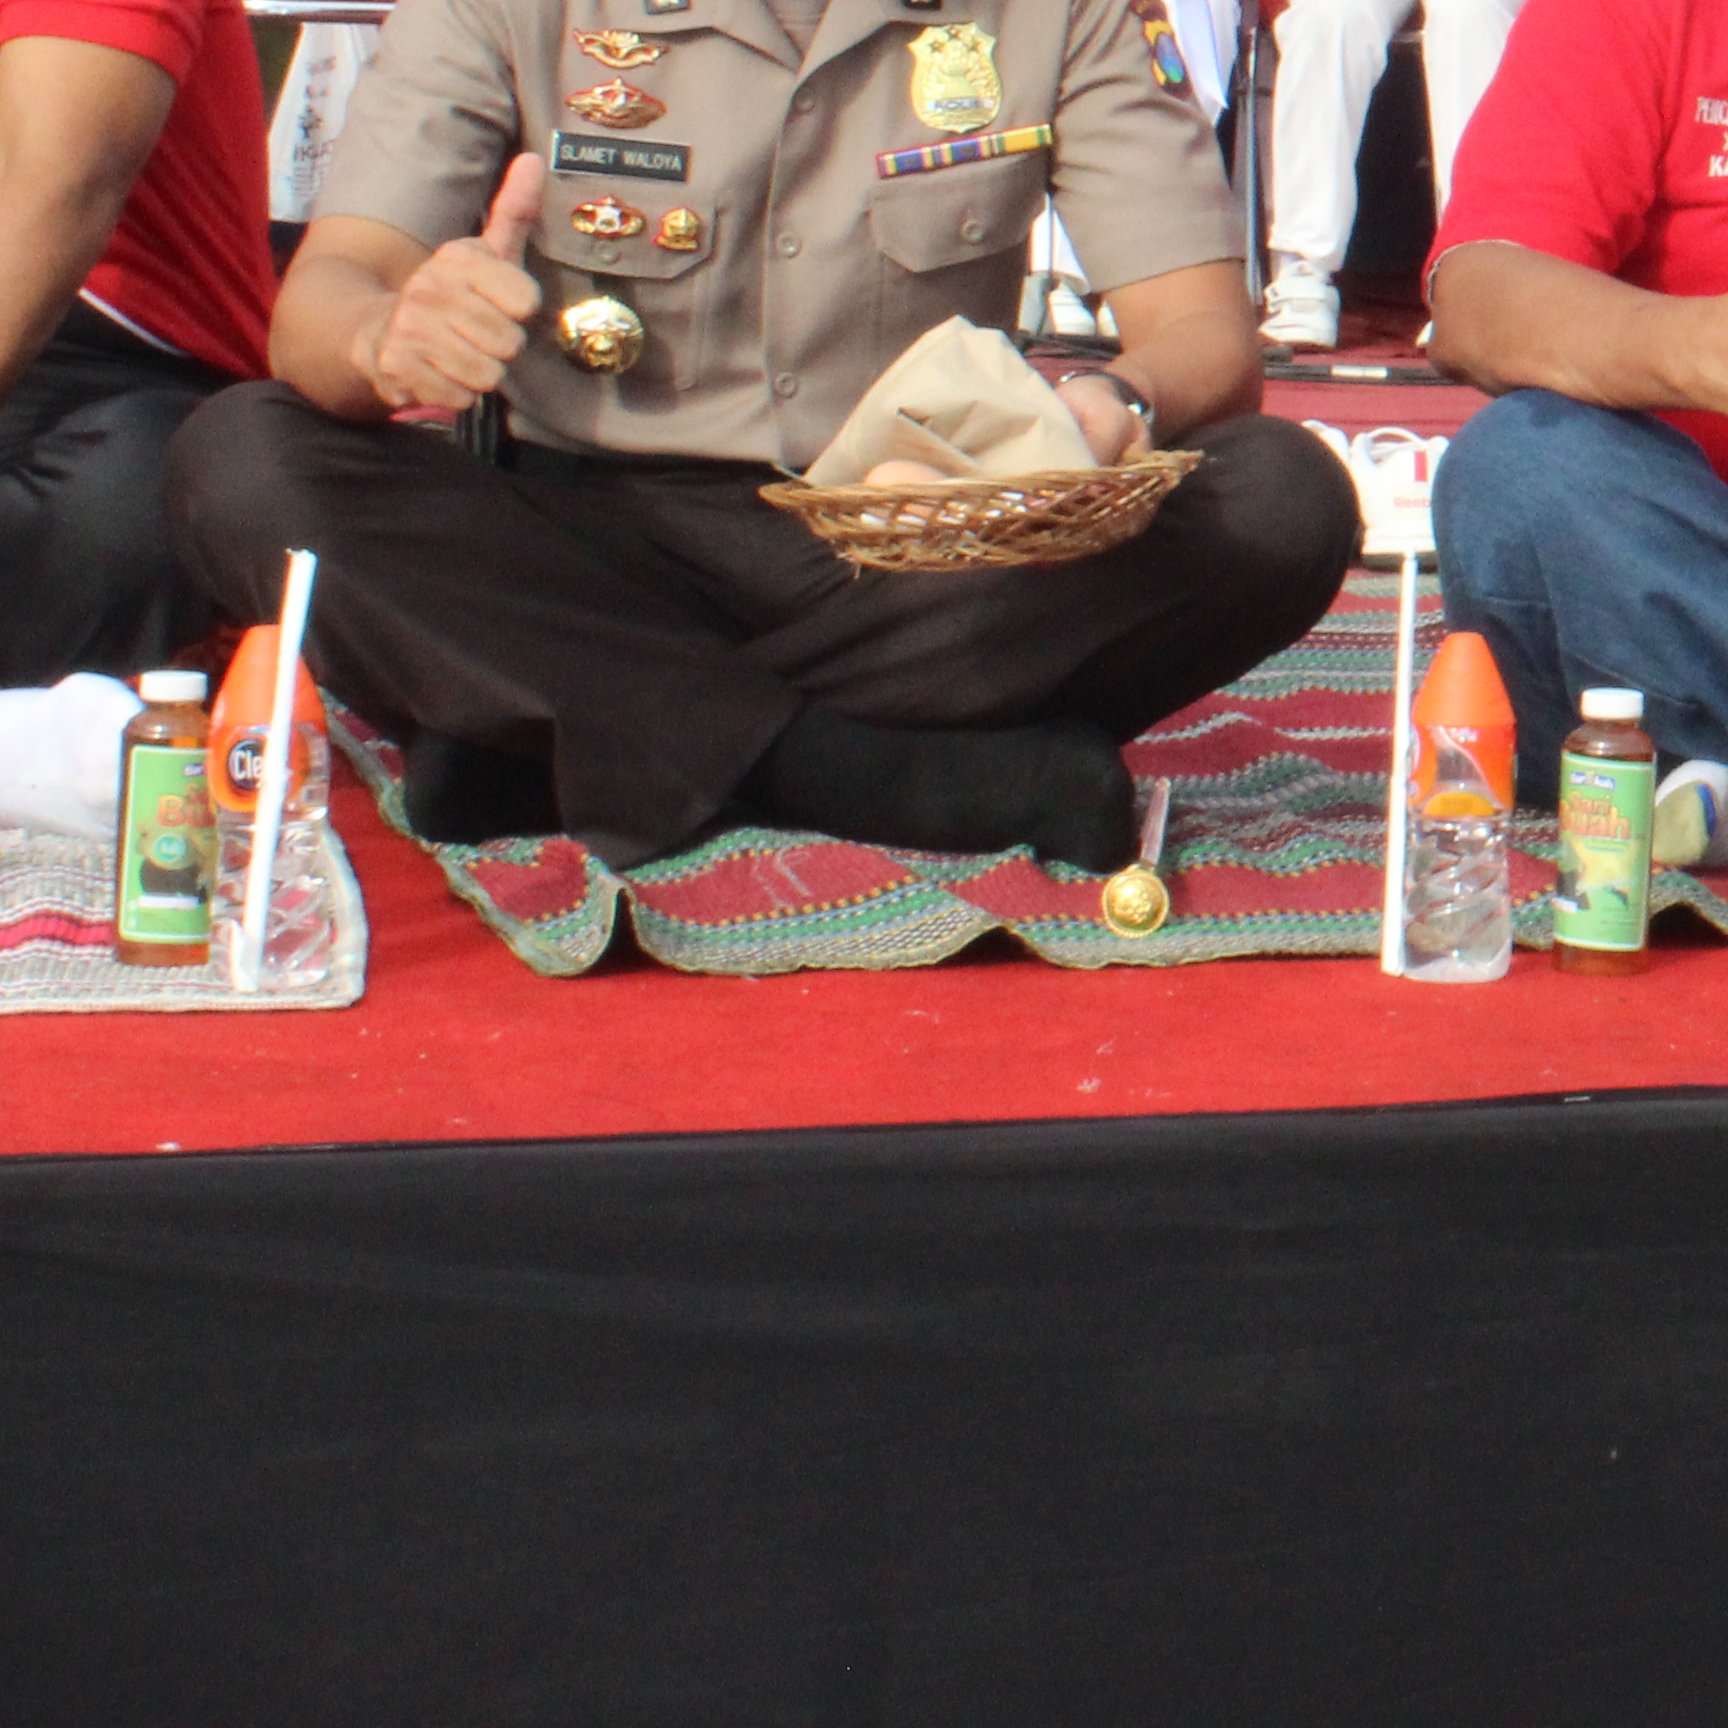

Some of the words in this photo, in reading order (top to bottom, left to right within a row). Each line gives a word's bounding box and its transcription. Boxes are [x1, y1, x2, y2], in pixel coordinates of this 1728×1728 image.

[560, 143, 617, 165] SLAMET
[1393, 496, 1432, 509] Reeb
[233, 750, 265, 780] Cle
